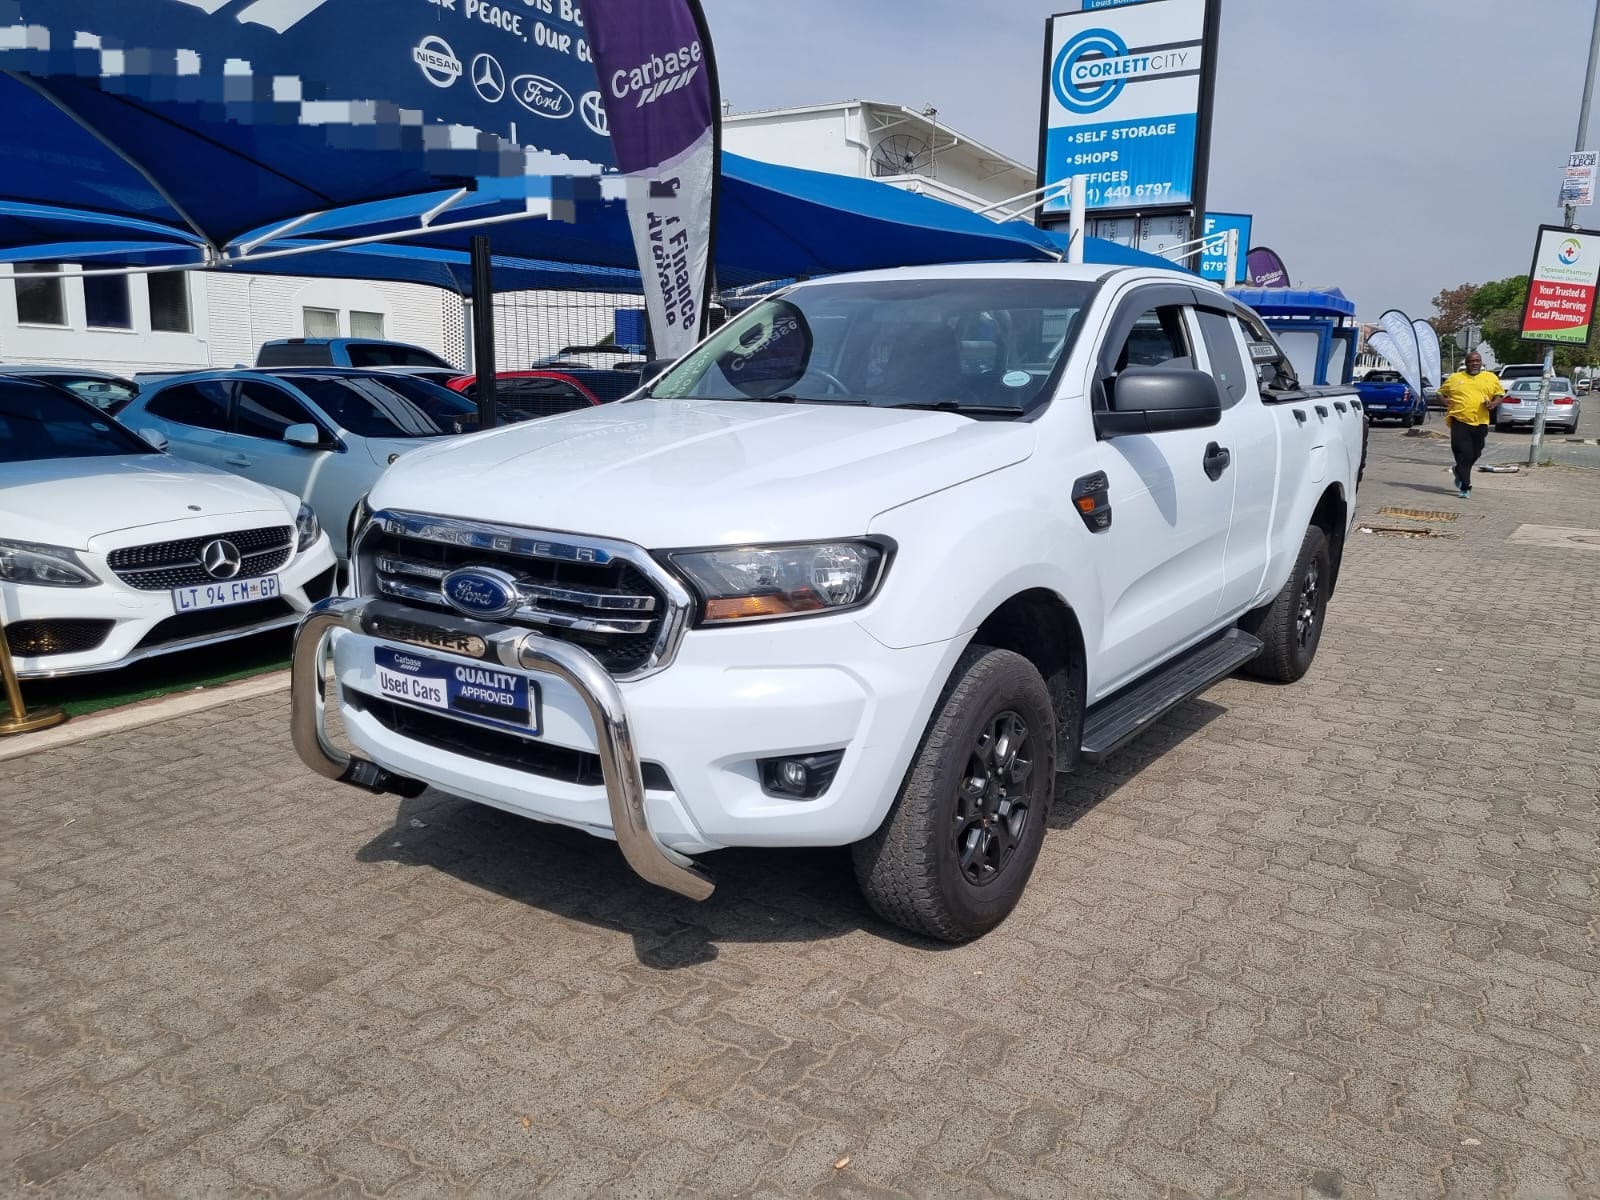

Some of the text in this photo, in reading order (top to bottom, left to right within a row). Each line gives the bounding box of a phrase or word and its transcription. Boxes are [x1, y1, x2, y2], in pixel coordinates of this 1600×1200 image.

[534, 22, 571, 54] OUR
[416, 51, 460, 72] NISSAN
[611, 41, 701, 98] Carbase
[524, 81, 563, 112] Ford
[1075, 123, 1176, 144] SELF STORAGE
[1074, 150, 1119, 165] SHOPS
[1103, 185, 1131, 199] 440
[1135, 182, 1172, 196] 6797
[669, 228, 696, 331] Finance
[1255, 270, 1283, 283] Carbase
[1539, 285, 1586, 298] Your Trusted &
[1533, 297, 1587, 313] Longest Serving
[1531, 309, 1584, 325] Local Pharmacy
[179, 578, 275, 608] LT 94 FM GP
[455, 579, 493, 605] Ford
[394, 653, 422, 667] Carbase
[380, 671, 441, 703] Used Cars
[455, 666, 517, 691] QUALITY
[461, 686, 515, 706] APPROVED
